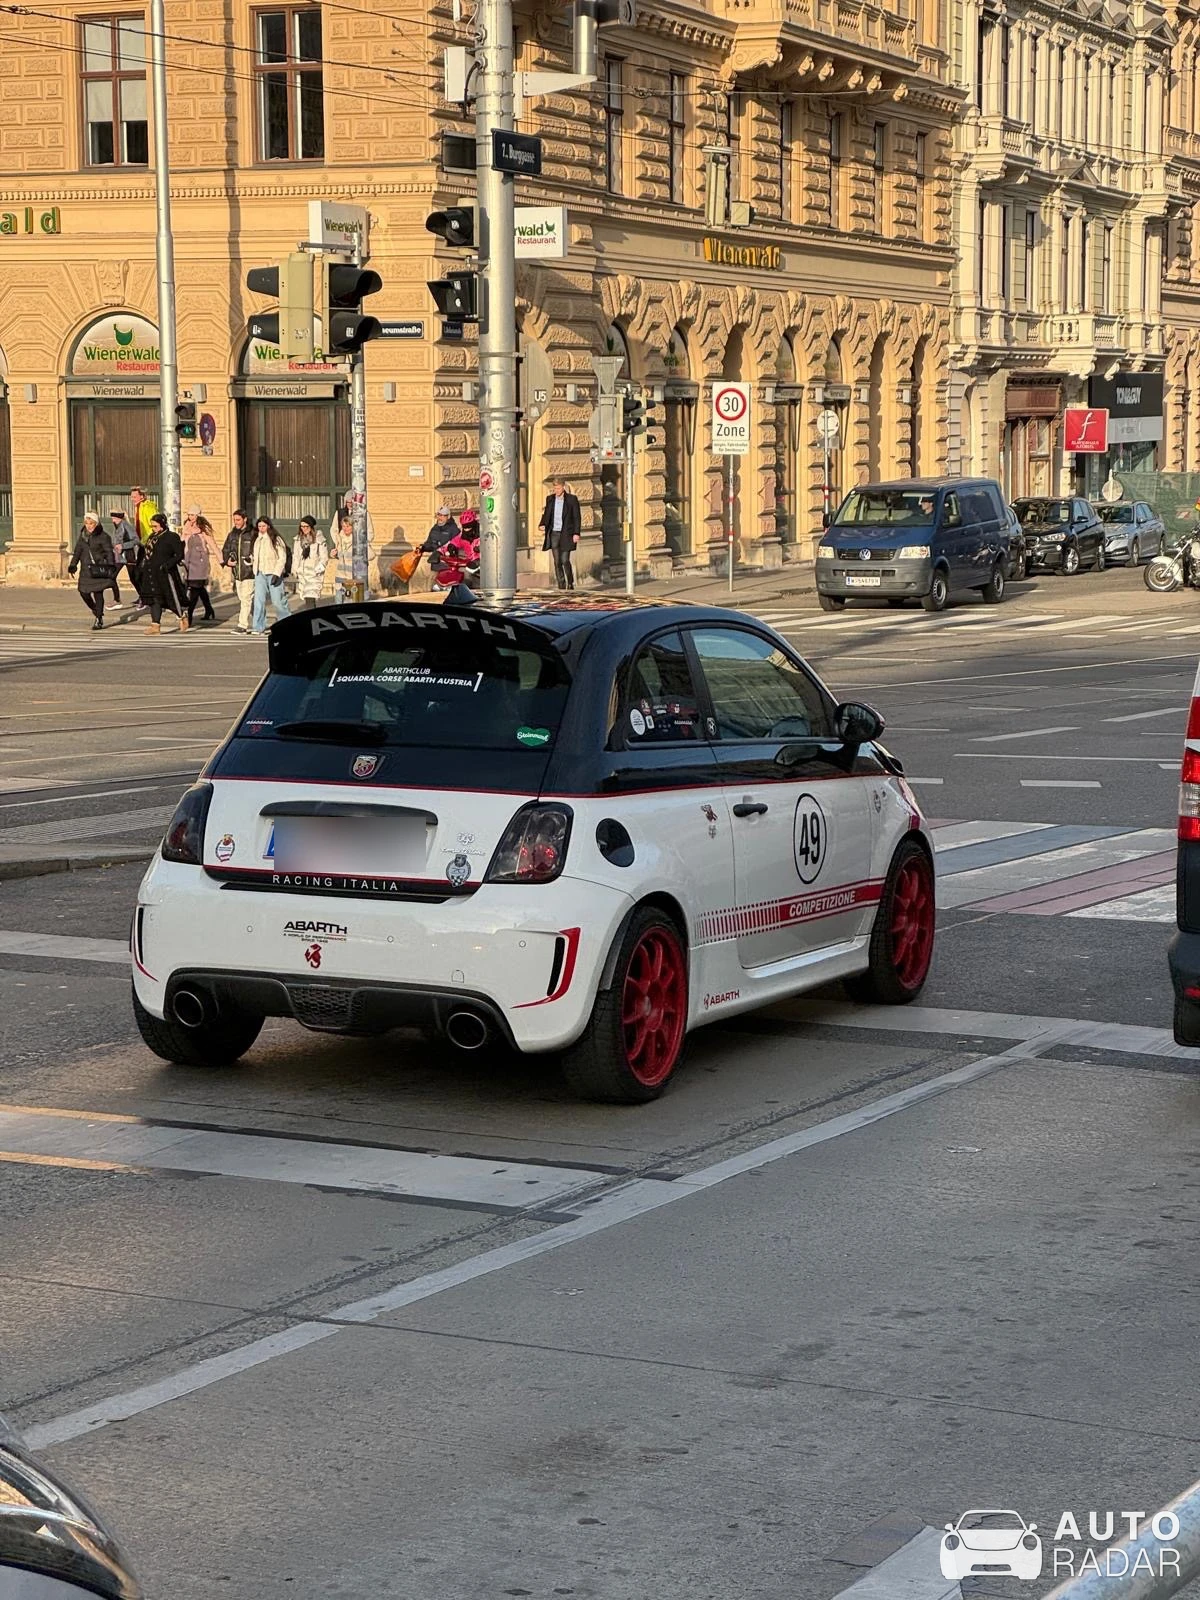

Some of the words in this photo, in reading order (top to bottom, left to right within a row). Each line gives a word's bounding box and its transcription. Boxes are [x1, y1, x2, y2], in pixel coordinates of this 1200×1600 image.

[508, 143, 535, 165] Burggasse
[324, 217, 358, 233] Wienerwald
[517, 236, 556, 244] Restaurant
[116, 361, 160, 371] Restauran
[92, 385, 144, 397] Wienerwald
[254, 385, 308, 396] Wienerwald
[723, 396, 739, 413] 30
[716, 423, 746, 437] Zone
[310, 611, 517, 641] ABARTH
[382, 666, 431, 675] ABARTHCLUB
[336, 675, 375, 683] SQUADRA
[376, 675, 402, 683] CORSE
[403, 676, 436, 684] ABARTH
[437, 678, 473, 687] AUSTRIA
[799, 811, 821, 866] 49
[272, 874, 333, 887] RACING
[342, 878, 398, 891] ITALIA
[789, 890, 856, 917] COMPETIZIONE
[284, 920, 348, 934] ABARTH
[709, 989, 741, 1006] ABARTH
